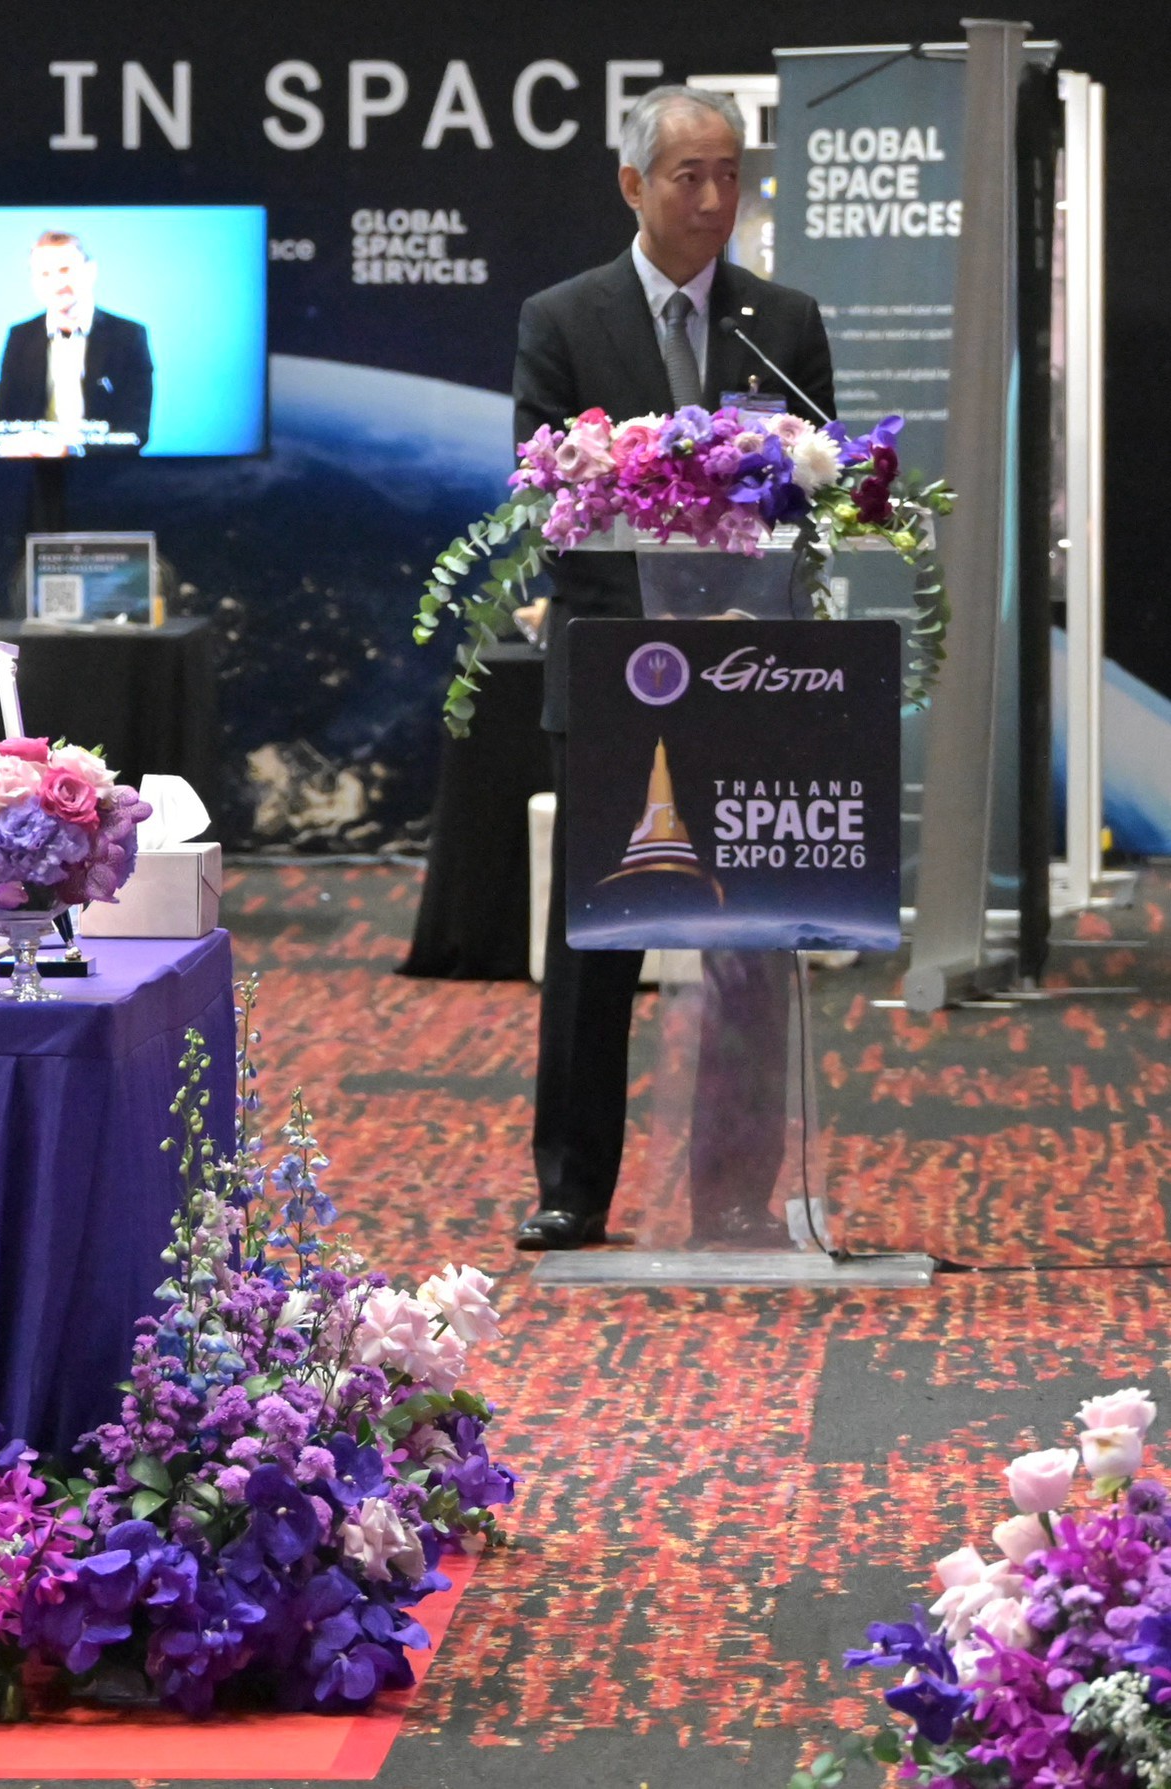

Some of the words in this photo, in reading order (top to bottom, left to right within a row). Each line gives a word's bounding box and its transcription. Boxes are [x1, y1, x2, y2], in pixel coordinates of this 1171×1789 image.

[48, 61, 191, 150] IN
[807, 126, 945, 164] GLOBAL
[806, 165, 920, 201] SPACE
[351, 208, 468, 234] GLOBAL
[804, 200, 964, 239] SERVICES
[351, 234, 447, 260] SPACE
[351, 258, 489, 284] SERVICES
[714, 780, 863, 797] THAILAND
[713, 800, 865, 841] SPACE
[715, 844, 786, 868] EXPO
[794, 844, 867, 869] 2026
